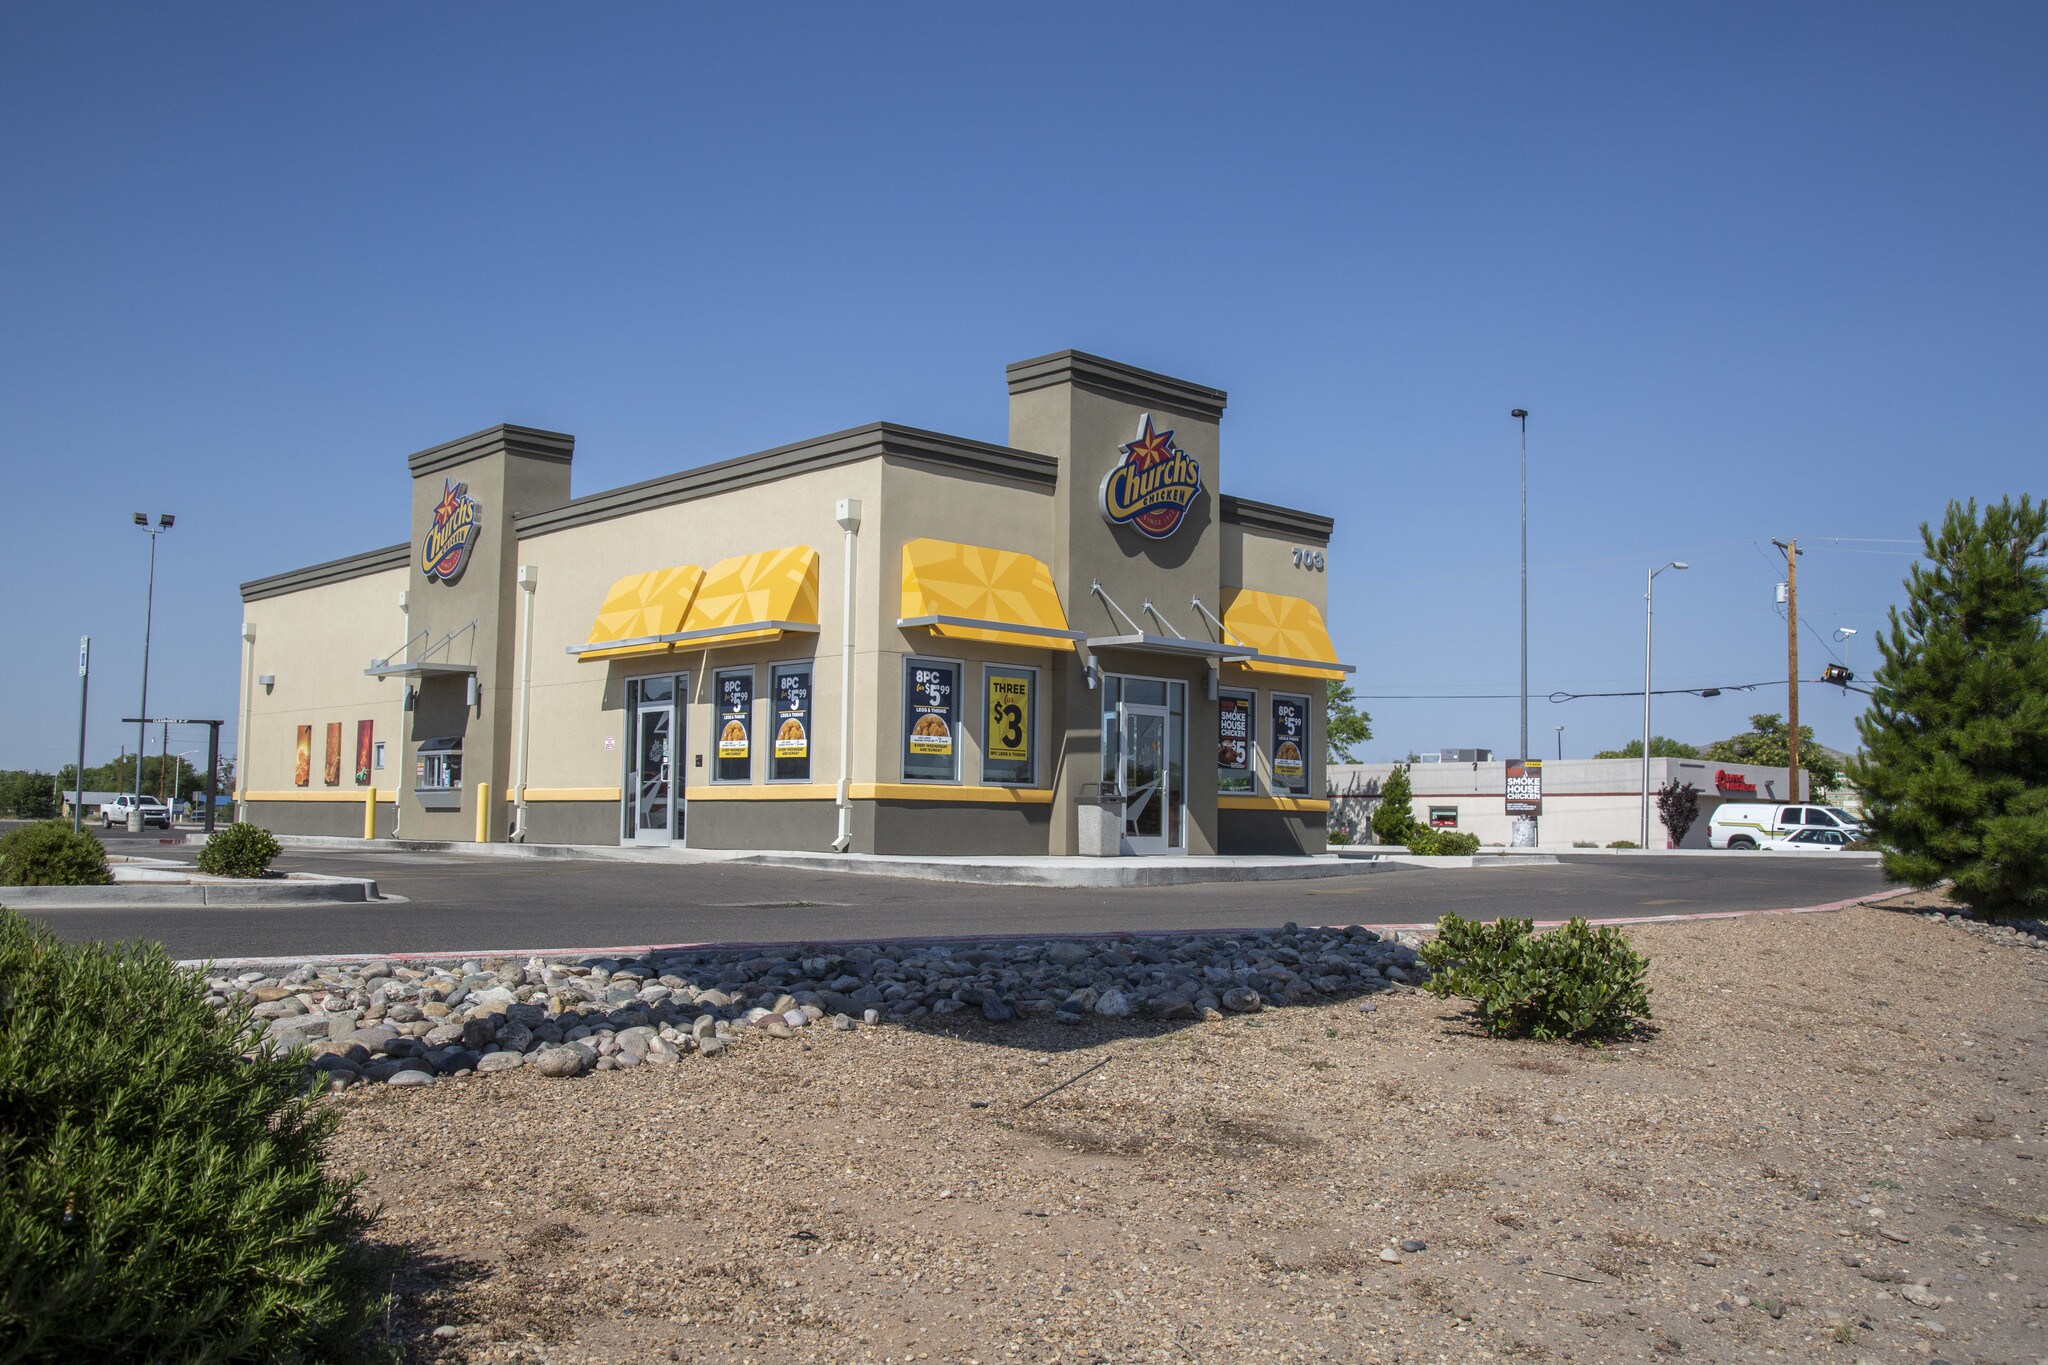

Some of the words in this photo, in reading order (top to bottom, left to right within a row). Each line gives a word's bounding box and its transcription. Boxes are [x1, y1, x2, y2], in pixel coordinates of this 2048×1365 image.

[1107, 451, 1198, 519] Church's
[1142, 490, 1184, 506] CHICKEN
[422, 496, 473, 572] Church's
[916, 670, 940, 683] 8PC
[724, 680, 740, 692] 8PC
[781, 677, 798, 689] 8PC
[916, 683, 925, 692] for
[994, 682, 1025, 694] THREE
[1003, 694, 1014, 704] for
[1221, 712, 1246, 721] SMOKE
[1279, 706, 1294, 716] 8PC
[994, 701, 1022, 748] $3
[1221, 720, 1246, 730] HOUSE
[1221, 729, 1245, 737] CHICKEN
[1232, 740, 1246, 763] $5
[1507, 785, 1540, 793] HOUSE
